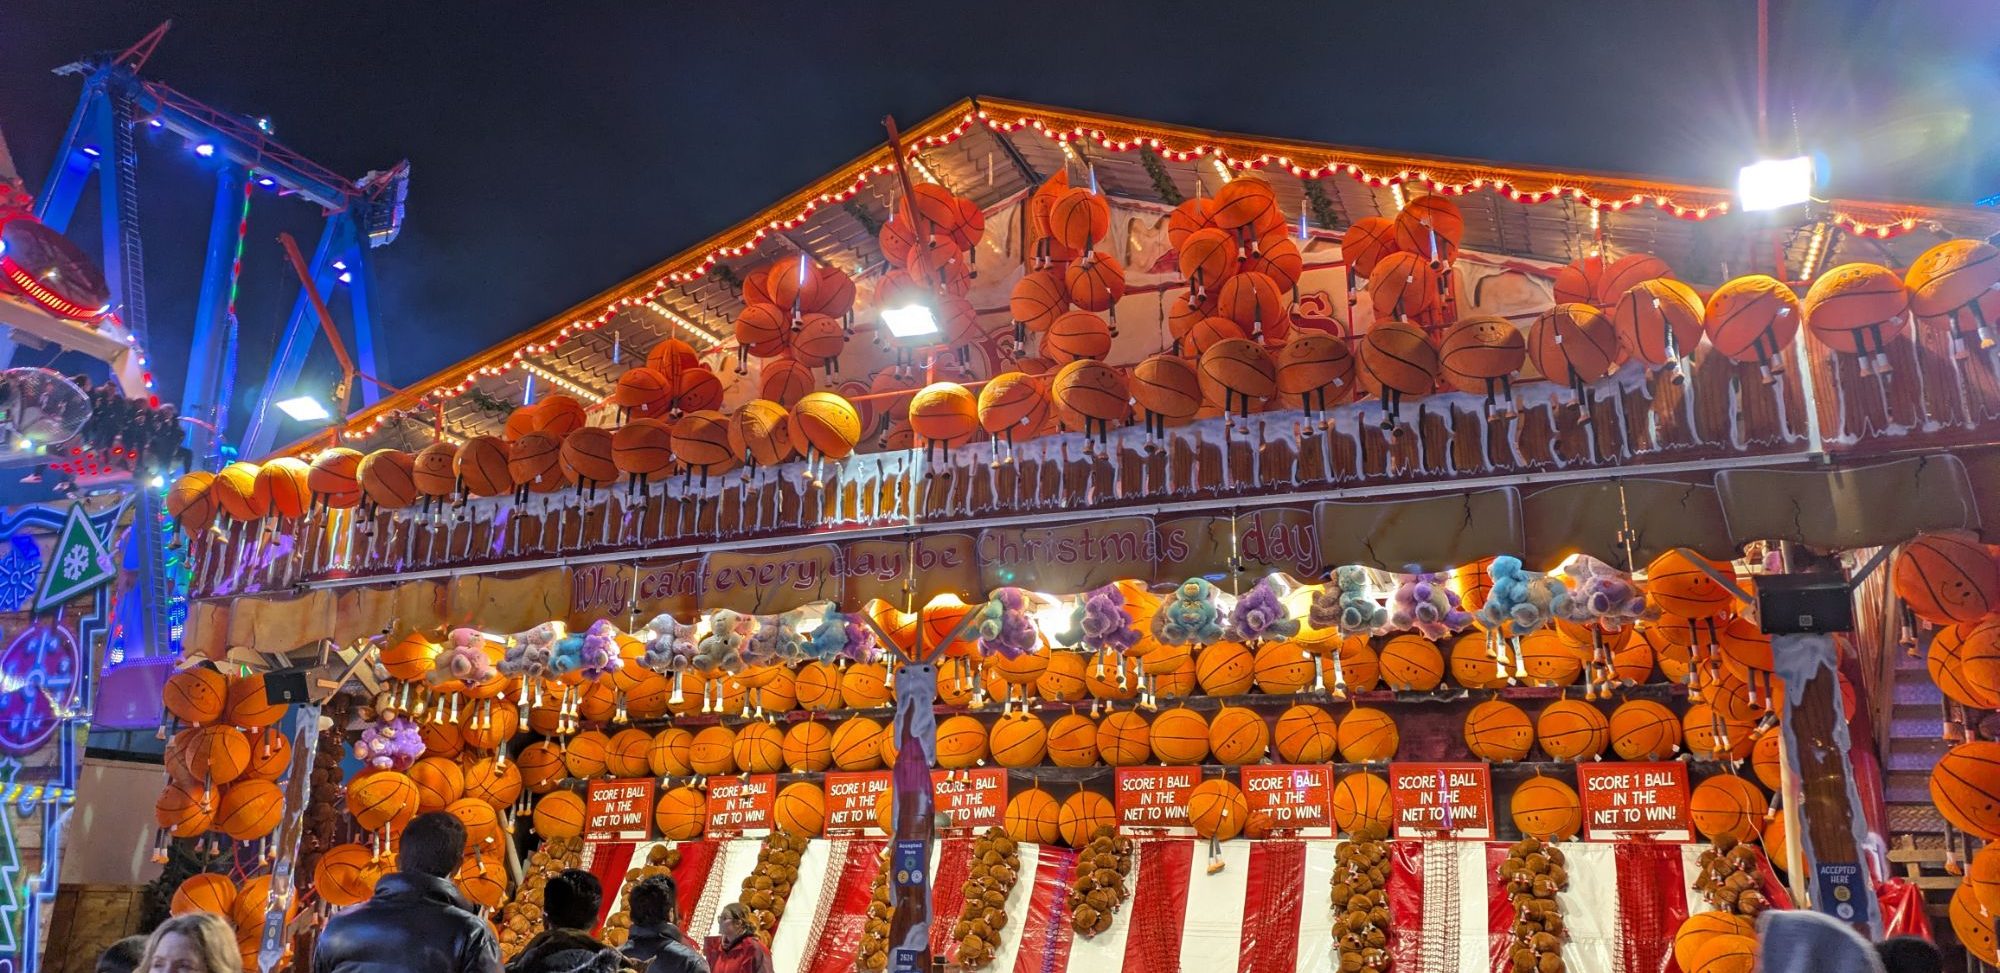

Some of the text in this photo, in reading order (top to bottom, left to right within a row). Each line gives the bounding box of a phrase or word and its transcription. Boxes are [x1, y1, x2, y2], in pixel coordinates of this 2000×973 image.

[573, 565, 629, 618] Why
[714, 560, 818, 590] every
[829, 544, 903, 582] day
[914, 538, 962, 572] be
[977, 526, 1190, 569] Christmas
[1240, 510, 1319, 577] day
[831, 780, 888, 796] SCORE 1 BALL
[936, 781, 965, 794] SCORE
[976, 777, 997, 790] BALL
[1122, 774, 1190, 791] SCORE 1 BALL
[1248, 774, 1321, 791] SCORE 1 BALL
[1398, 773, 1477, 789] SCORE 1 BALL
[1588, 772, 1675, 790] SCORE 1 BALL
[592, 786, 645, 801] SCORE 1 BALL
[712, 786, 739, 798] SCORE
[749, 783, 767, 794] BALL
[1269, 791, 1305, 805] IN THE
[1420, 790, 1460, 804] IN THE
[1614, 790, 1656, 806] IN THE
[726, 797, 754, 810] IN THE
[846, 795, 876, 808] IN THE
[952, 793, 983, 806] IN THE
[1141, 792, 1175, 805] IN THE
[605, 801, 632, 813] IN THE
[958, 808, 970, 820] TO
[974, 806, 996, 819] WIN!
[1124, 806, 1188, 820] NET TO WIN!
[1277, 808, 1291, 820] TO
[1295, 805, 1321, 819] WIN!
[1402, 805, 1476, 821] NET TO WIN!
[592, 812, 641, 827] NET TO WIN!
[712, 810, 765, 825] NET TO WIN!
[831, 810, 849, 823] NET
[851, 810, 863, 821] TO
[1595, 806, 1676, 824] NET TO WIN!
[1820, 866, 1856, 874] ACCEPTED
[1830, 875, 1849, 884] HERE
